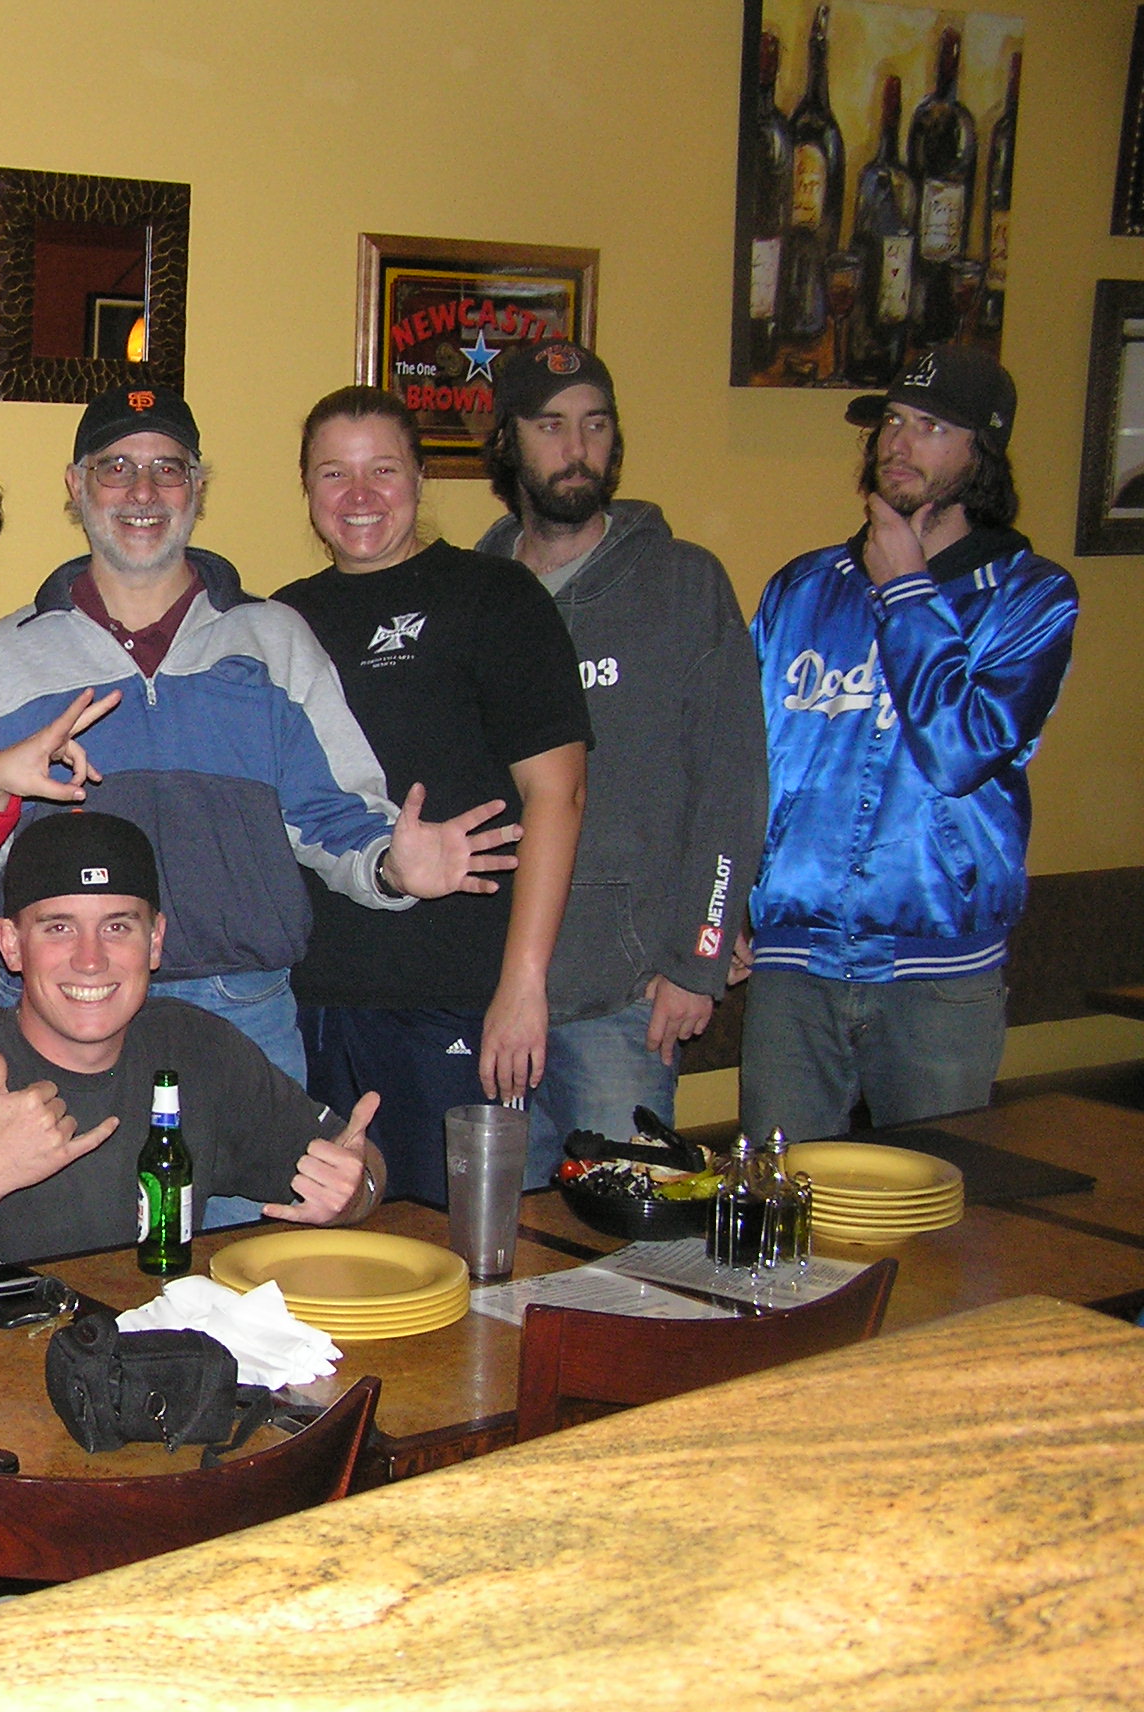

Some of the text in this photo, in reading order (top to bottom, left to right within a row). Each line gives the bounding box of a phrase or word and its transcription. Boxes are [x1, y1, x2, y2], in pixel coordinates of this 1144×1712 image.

[396, 361, 437, 376] The One
[406, 384, 494, 413] BROWN
[707, 854, 732, 927] JETPILOT
